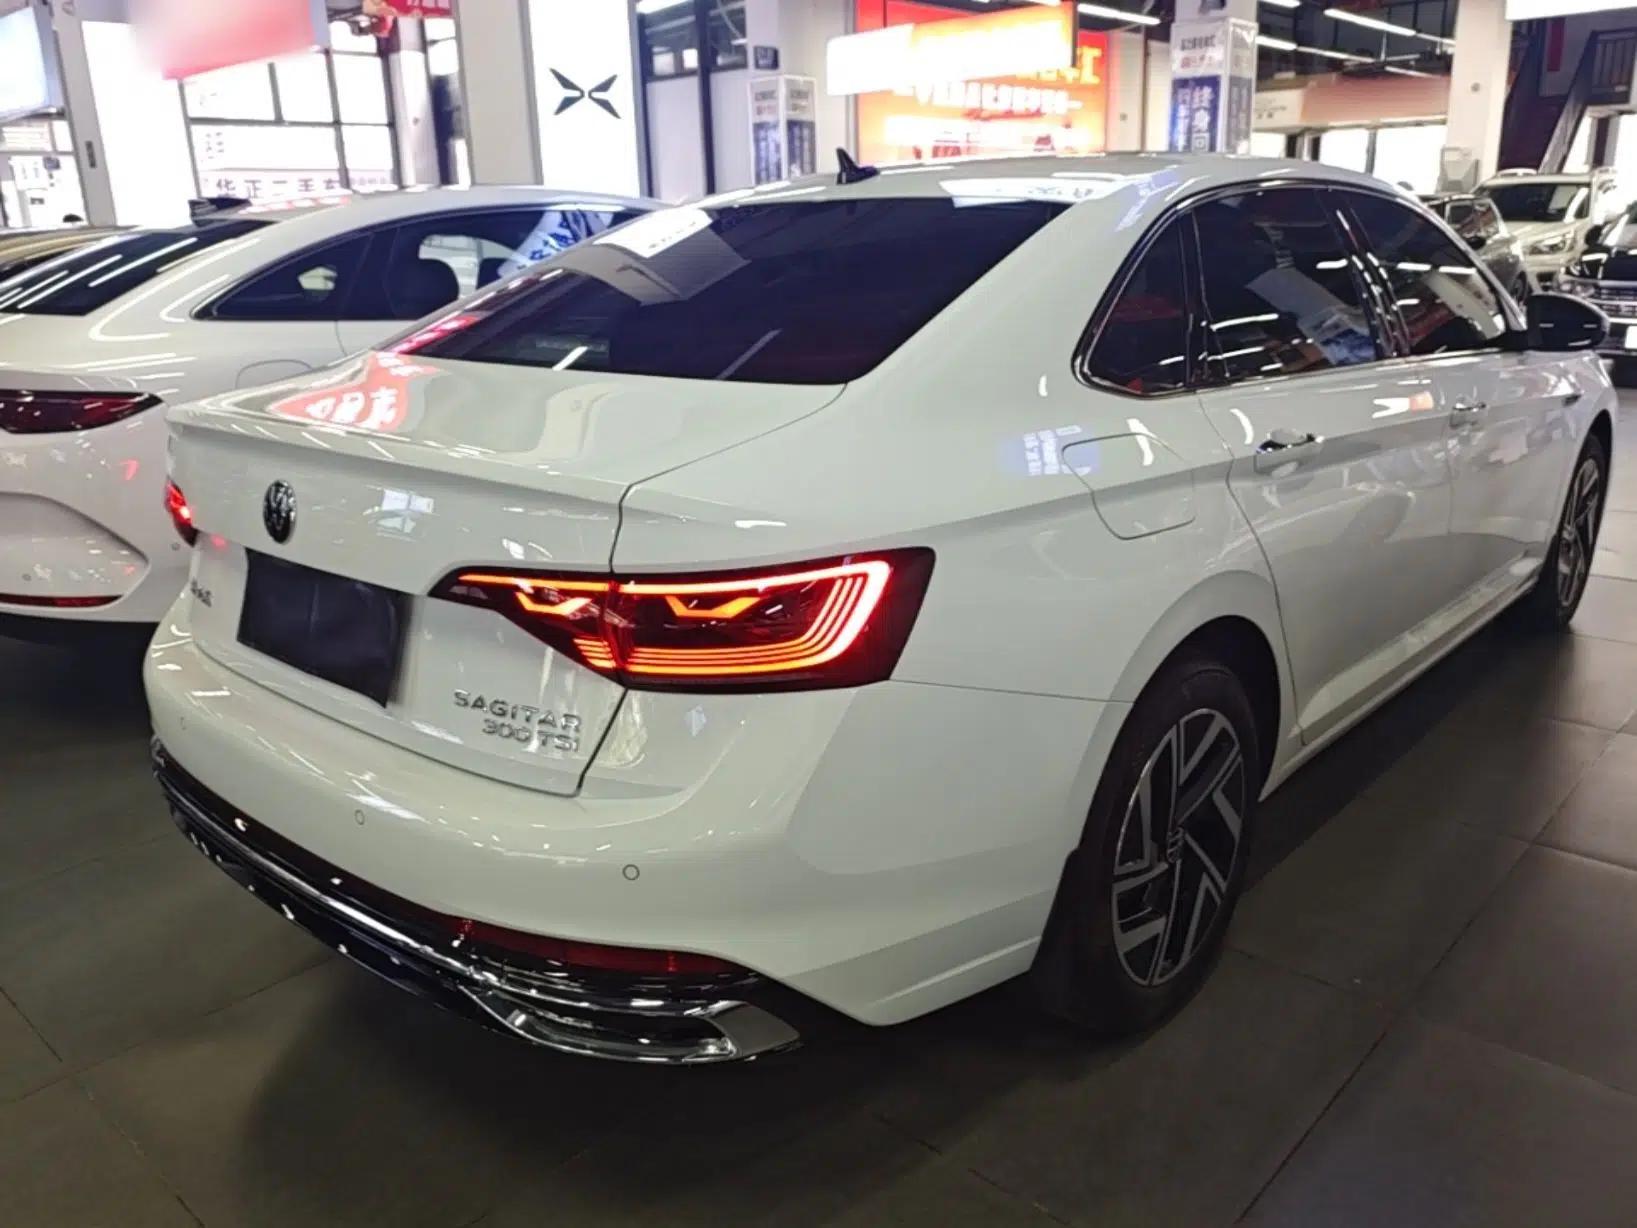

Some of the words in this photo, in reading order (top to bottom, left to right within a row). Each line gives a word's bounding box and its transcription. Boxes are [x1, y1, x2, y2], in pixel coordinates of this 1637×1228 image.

[453, 689, 581, 733] SAGITAR
[482, 719, 532, 743] 300
[537, 729, 580, 753] TSI
